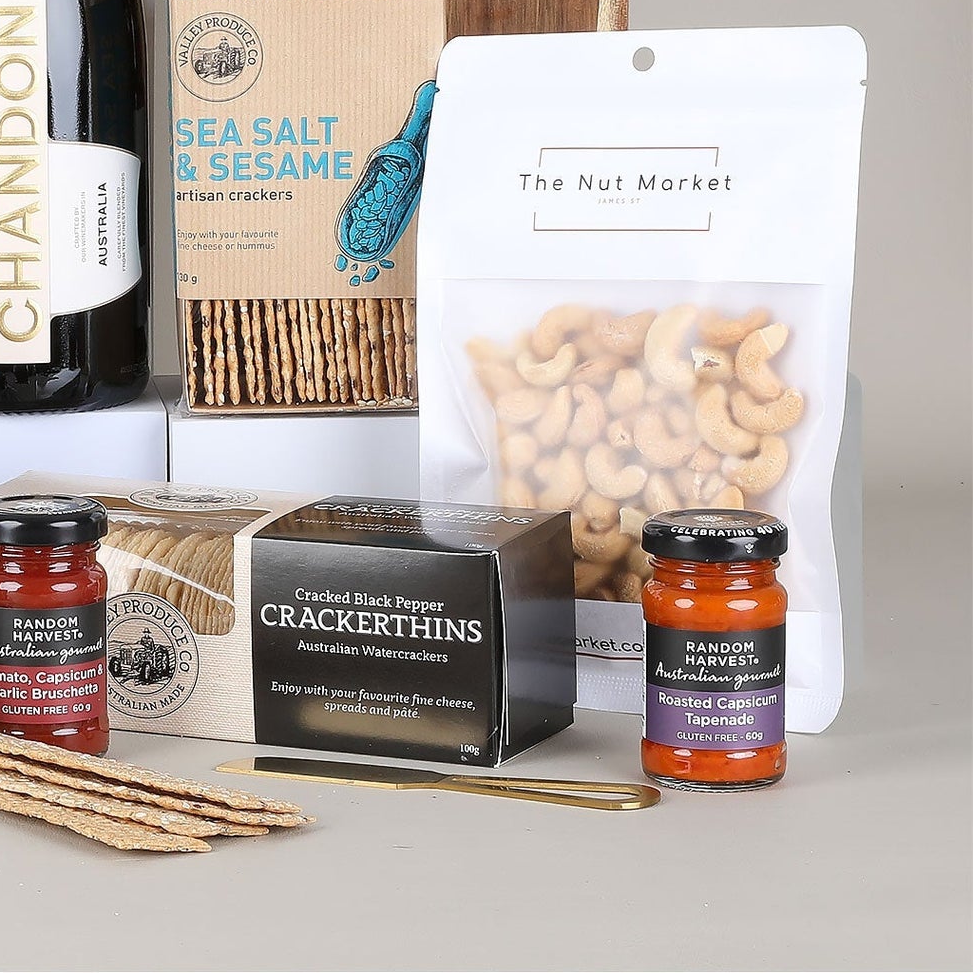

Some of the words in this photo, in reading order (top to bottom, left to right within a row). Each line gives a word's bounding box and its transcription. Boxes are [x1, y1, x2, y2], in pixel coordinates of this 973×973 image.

[178, 21, 204, 68] VALLEY
[205, 17, 257, 48] PRODUCE
[175, 117, 243, 148] SEA
[252, 116, 339, 146] SALT
[176, 152, 199, 182] &
[208, 151, 353, 182] SESAME
[519, 173, 564, 191] The
[578, 174, 623, 191] Nut
[637, 174, 732, 191] Market
[176, 188, 224, 202] artisan
[228, 188, 293, 201] crackers
[97, 182, 108, 267] AUSTRALIA
[177, 229, 197, 240] Enjoy
[198, 230, 217, 239] with
[219, 230, 238, 241] your
[241, 229, 279, 238] favourite
[192, 241, 223, 250] cheese
[237, 241, 276, 250] hummus
[670, 524, 755, 538] CELEBRATING
[757, 523, 773, 536] 40
[294, 587, 351, 605] Cracked
[353, 592, 392, 609] Black
[395, 596, 445, 613] Pepper
[13, 616, 78, 629] RANDOM
[122, 599, 189, 647] PRODUCE
[259, 603, 483, 644] CRACKERTHINS
[59, 636, 104, 666] gourmet
[297, 639, 360, 657] Australian
[361, 643, 449, 664] Watercrackers
[686, 640, 755, 654] RANDOM
[35, 668, 96, 686] Capsicum
[97, 663, 104, 676] &
[655, 661, 732, 683] Australian
[733, 663, 782, 691] gourmet
[31, 683, 99, 701] Bruschetta
[107, 683, 158, 711] STRALIAN
[160, 683, 185, 708] MADE
[270, 680, 302, 695] Enjoy
[303, 683, 329, 697] with
[330, 687, 357, 701] your
[357, 688, 410, 705] favourite
[410, 693, 434, 708] fine
[435, 694, 477, 711] cheese,
[658, 691, 712, 709] Roasted
[716, 692, 778, 711] Capsicum
[1, 705, 42, 715] GLUTEN
[43, 705, 68, 715] FREE
[323, 701, 368, 716] spreads
[369, 703, 391, 716] and
[392, 704, 421, 719] pâté.
[684, 712, 756, 728] Tapenade
[676, 731, 712, 742] GLUTEN
[714, 732, 738, 742] FREE
[745, 731, 764, 743] 60g
[460, 743, 480, 757] 100g
